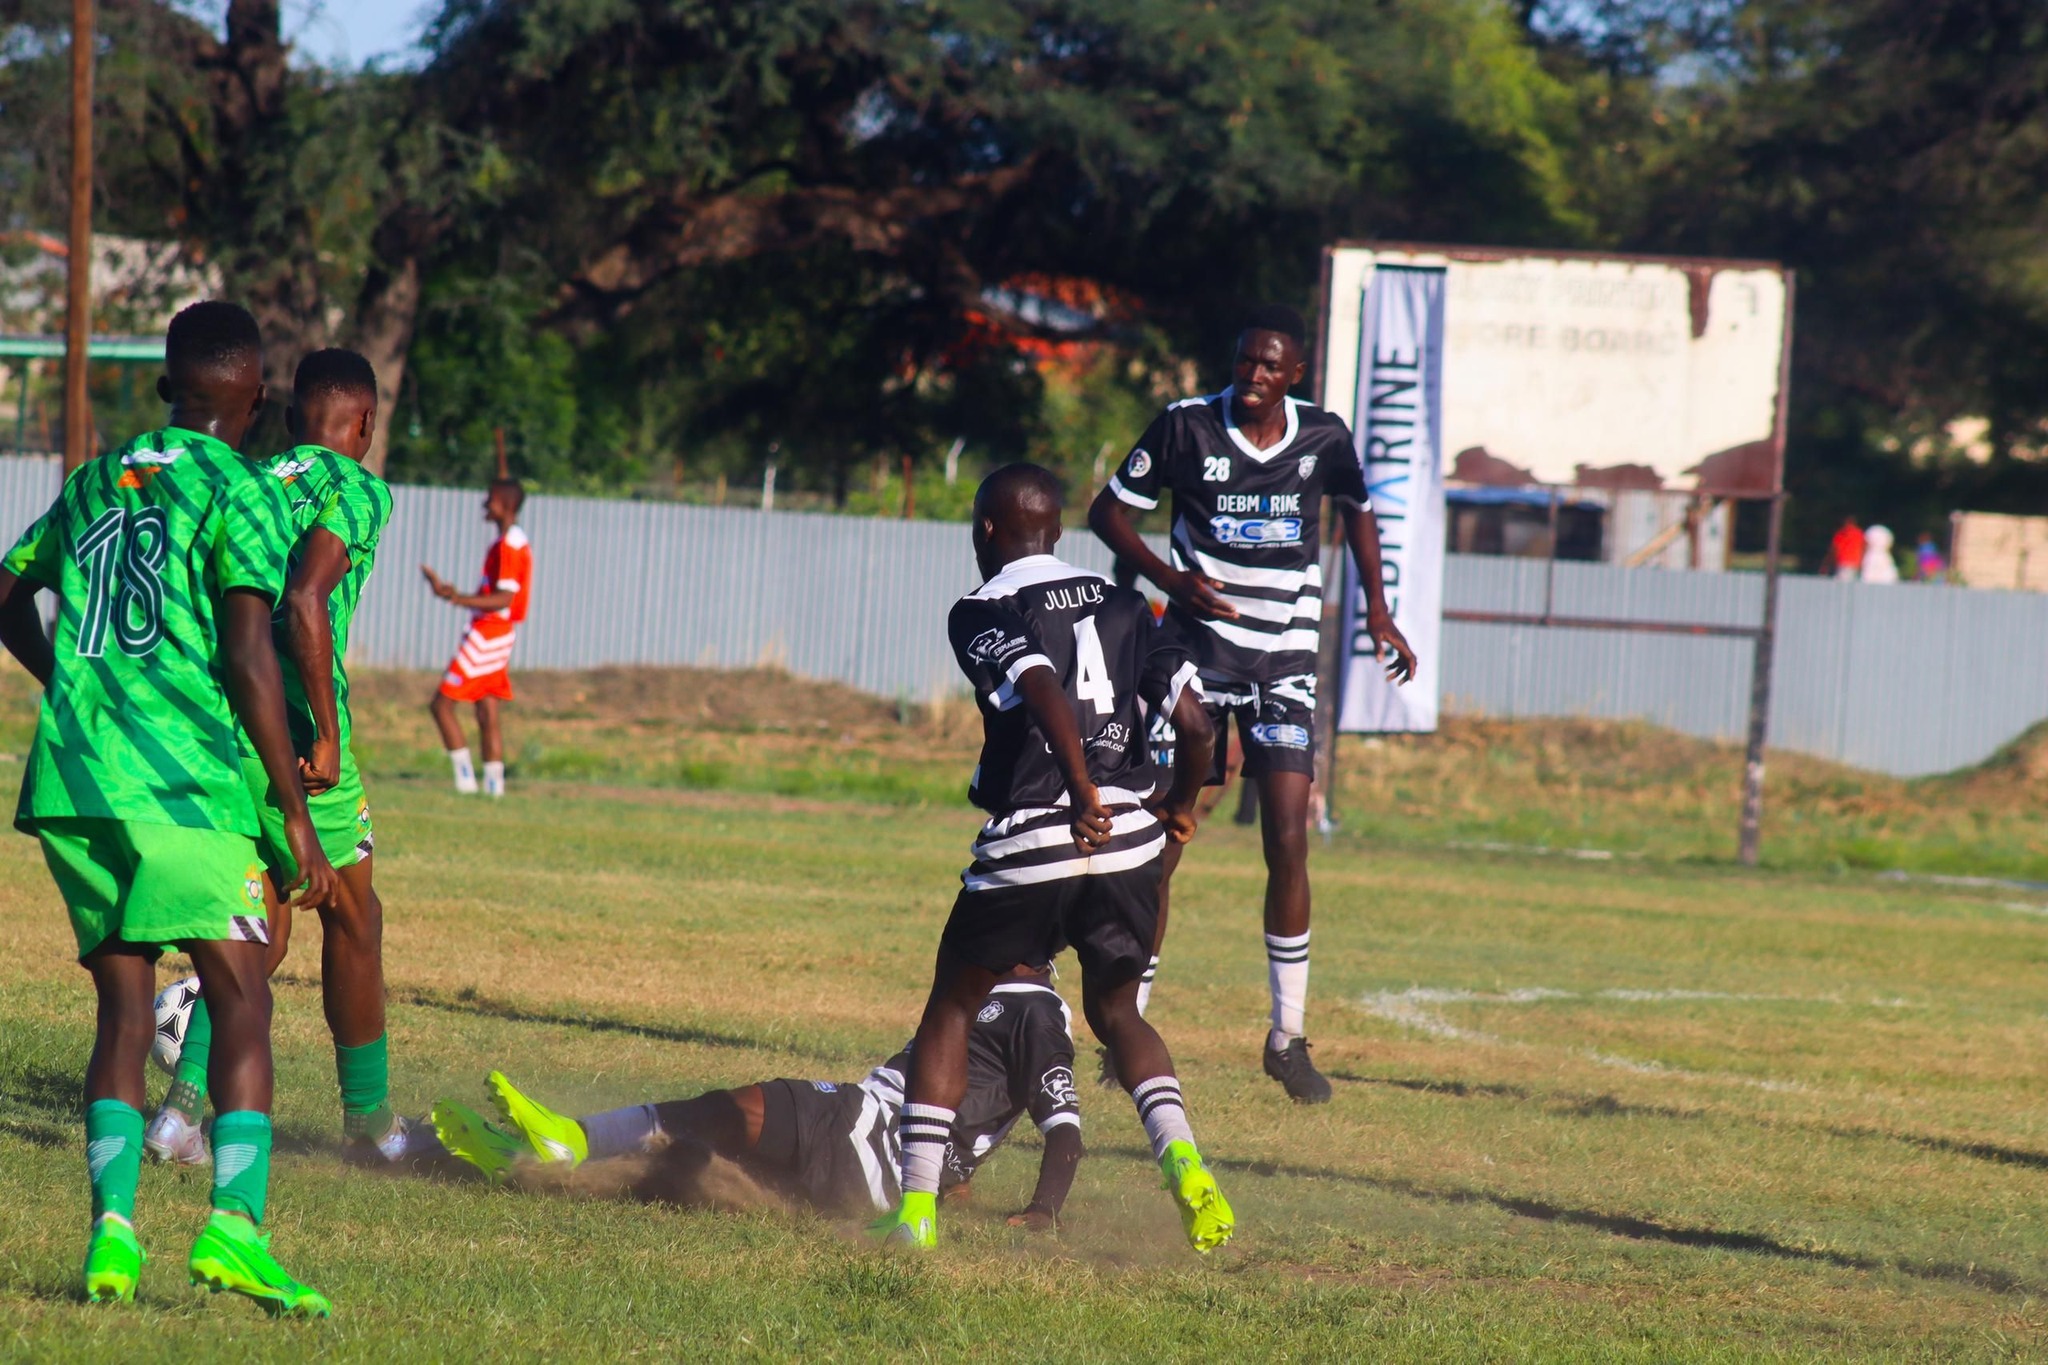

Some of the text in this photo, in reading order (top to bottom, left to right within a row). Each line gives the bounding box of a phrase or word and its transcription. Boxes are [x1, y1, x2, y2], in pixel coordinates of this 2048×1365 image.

[1203, 456, 1231, 482] 28
[1217, 493, 1301, 513] DEBMARINE
[75, 505, 168, 658] 18
[1045, 584, 1104, 610] JULIUS
[1073, 615, 1115, 715] 4
